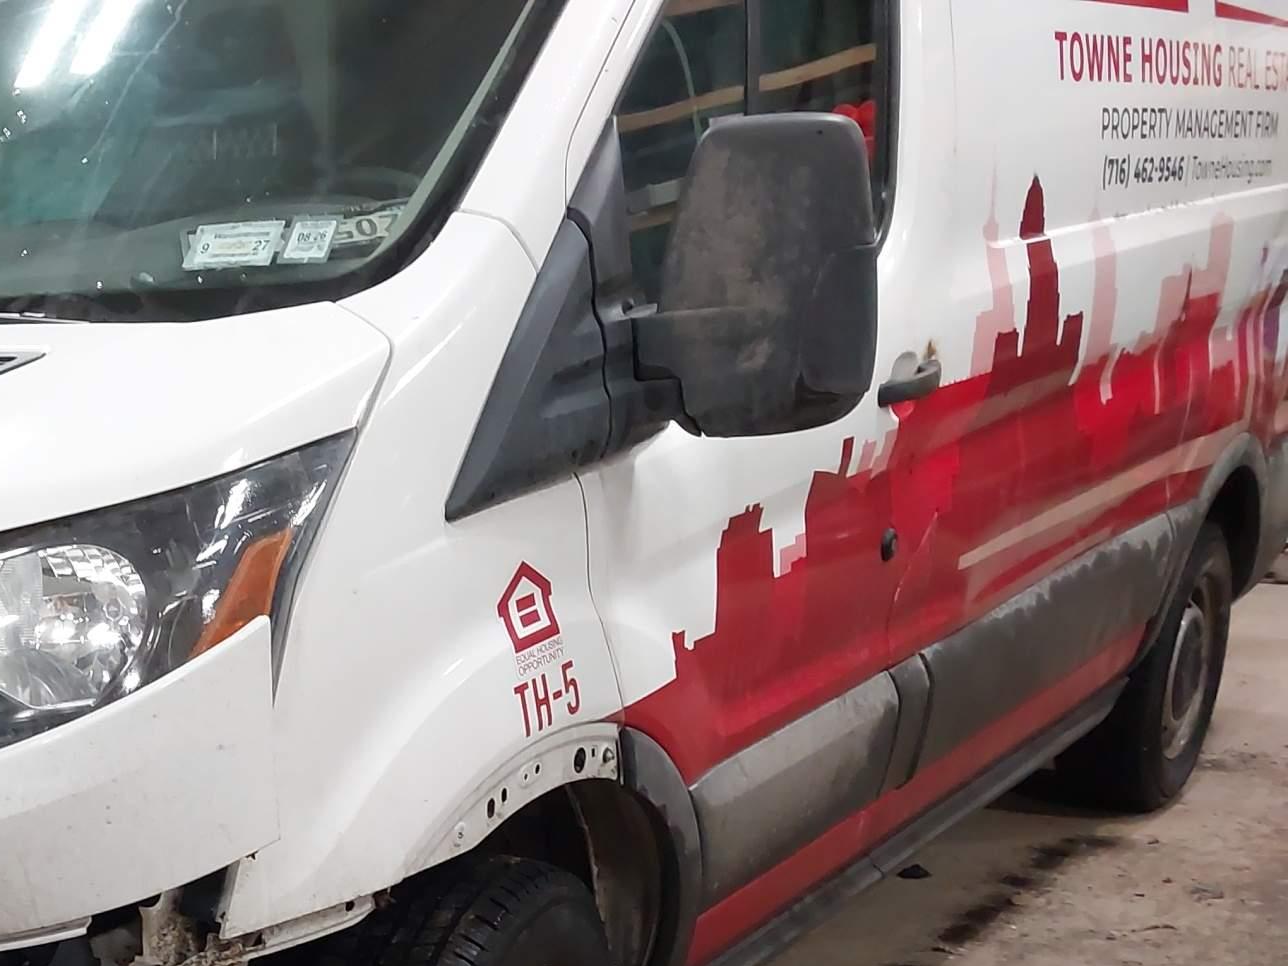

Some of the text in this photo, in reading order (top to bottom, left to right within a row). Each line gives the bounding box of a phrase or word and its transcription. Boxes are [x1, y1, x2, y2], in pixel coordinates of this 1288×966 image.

[1054, 31, 1133, 83] TOWNE
[1140, 37, 1223, 88] HOUSING
[1228, 46, 1261, 90] REAL
[1101, 107, 1280, 140] PROPERTY MANAGEMENT FIRM
[1102, 154, 1130, 190] (716)
[1134, 156, 1185, 183] 462-9546
[200, 242, 210, 255] 9
[252, 239, 271, 252] 27
[515, 636, 564, 666] EQUAL HOUSING
[518, 647, 565, 677] OPPORTUNITY
[514, 660, 580, 738] TH-5
